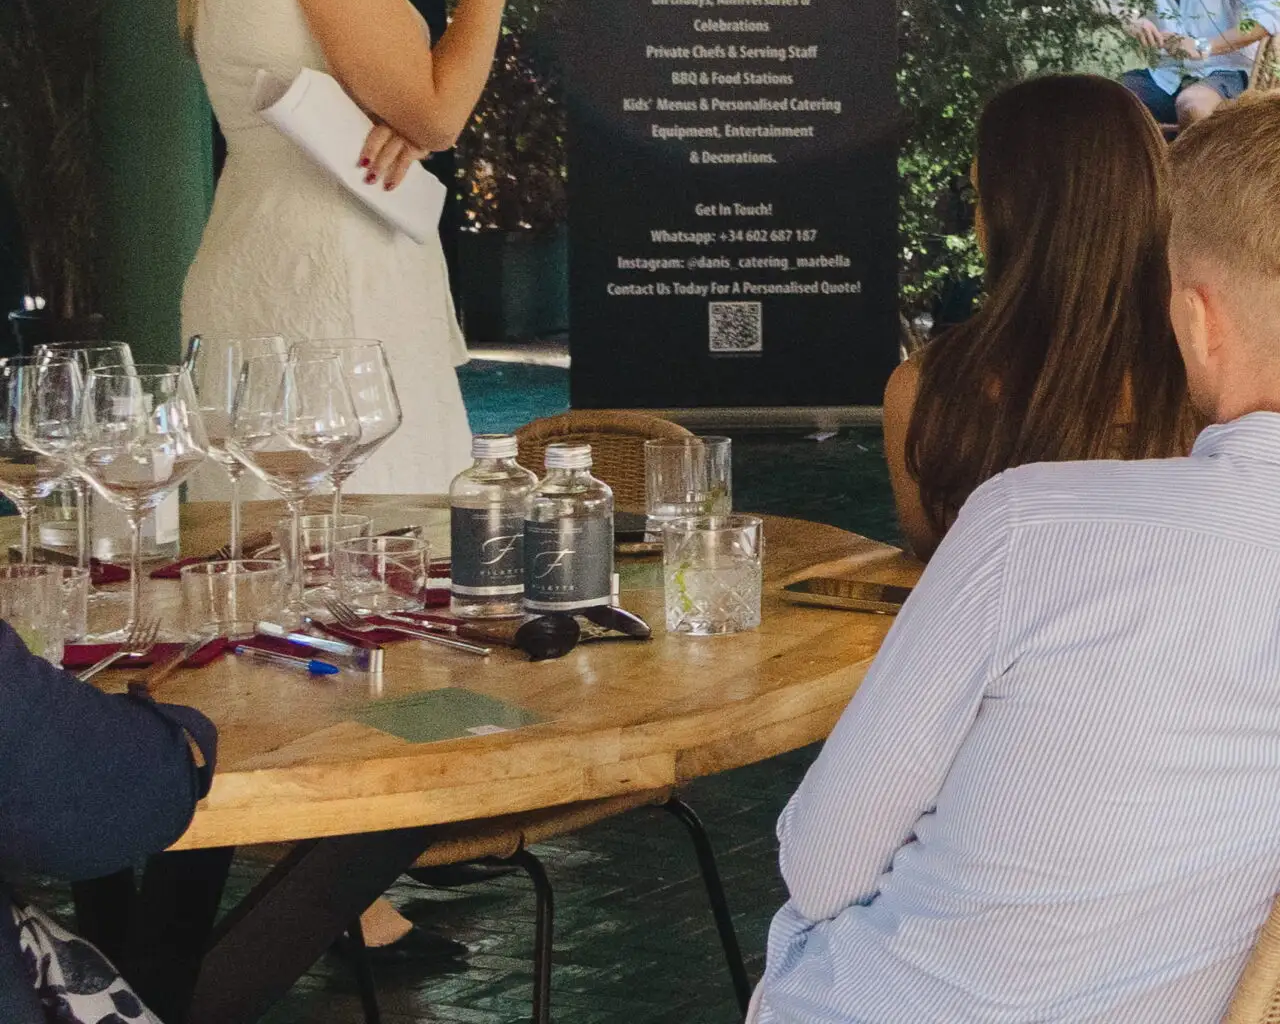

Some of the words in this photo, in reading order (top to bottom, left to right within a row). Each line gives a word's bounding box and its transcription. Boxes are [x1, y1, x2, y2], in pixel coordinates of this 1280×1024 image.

[693, 18, 770, 33] Celebrations
[645, 44, 691, 59] Private
[691, 44, 726, 59] Chefs
[727, 44, 738, 59] &
[739, 45, 787, 62] Serving
[788, 45, 818, 59] Staff
[671, 70, 698, 86] BBQ
[699, 71, 710, 85] &
[711, 71, 742, 85] Food
[743, 71, 794, 85] Stations
[657, 98, 697, 111] Menus
[699, 97, 709, 111] &
[711, 97, 788, 111] Personalised
[789, 97, 843, 115] Catering
[724, 123, 814, 138] Entertainment
[689, 150, 700, 164] &
[701, 150, 777, 164] Decorations.
[694, 202, 717, 217] Get
[718, 202, 732, 216] In
[733, 202, 773, 217] Touch!
[650, 229, 716, 246] Whatsapp:
[719, 229, 745, 243] +34
[745, 229, 768, 243] 602
[769, 228, 793, 242] 687
[796, 228, 818, 242] 187
[617, 255, 685, 273] Instagram:
[606, 282, 654, 296] Contact
[656, 282, 671, 296] Us
[673, 281, 709, 298] Today
[710, 281, 730, 295] For
[732, 281, 741, 294] A
[742, 280, 819, 295] Personalised
[820, 280, 862, 296] Quote!
